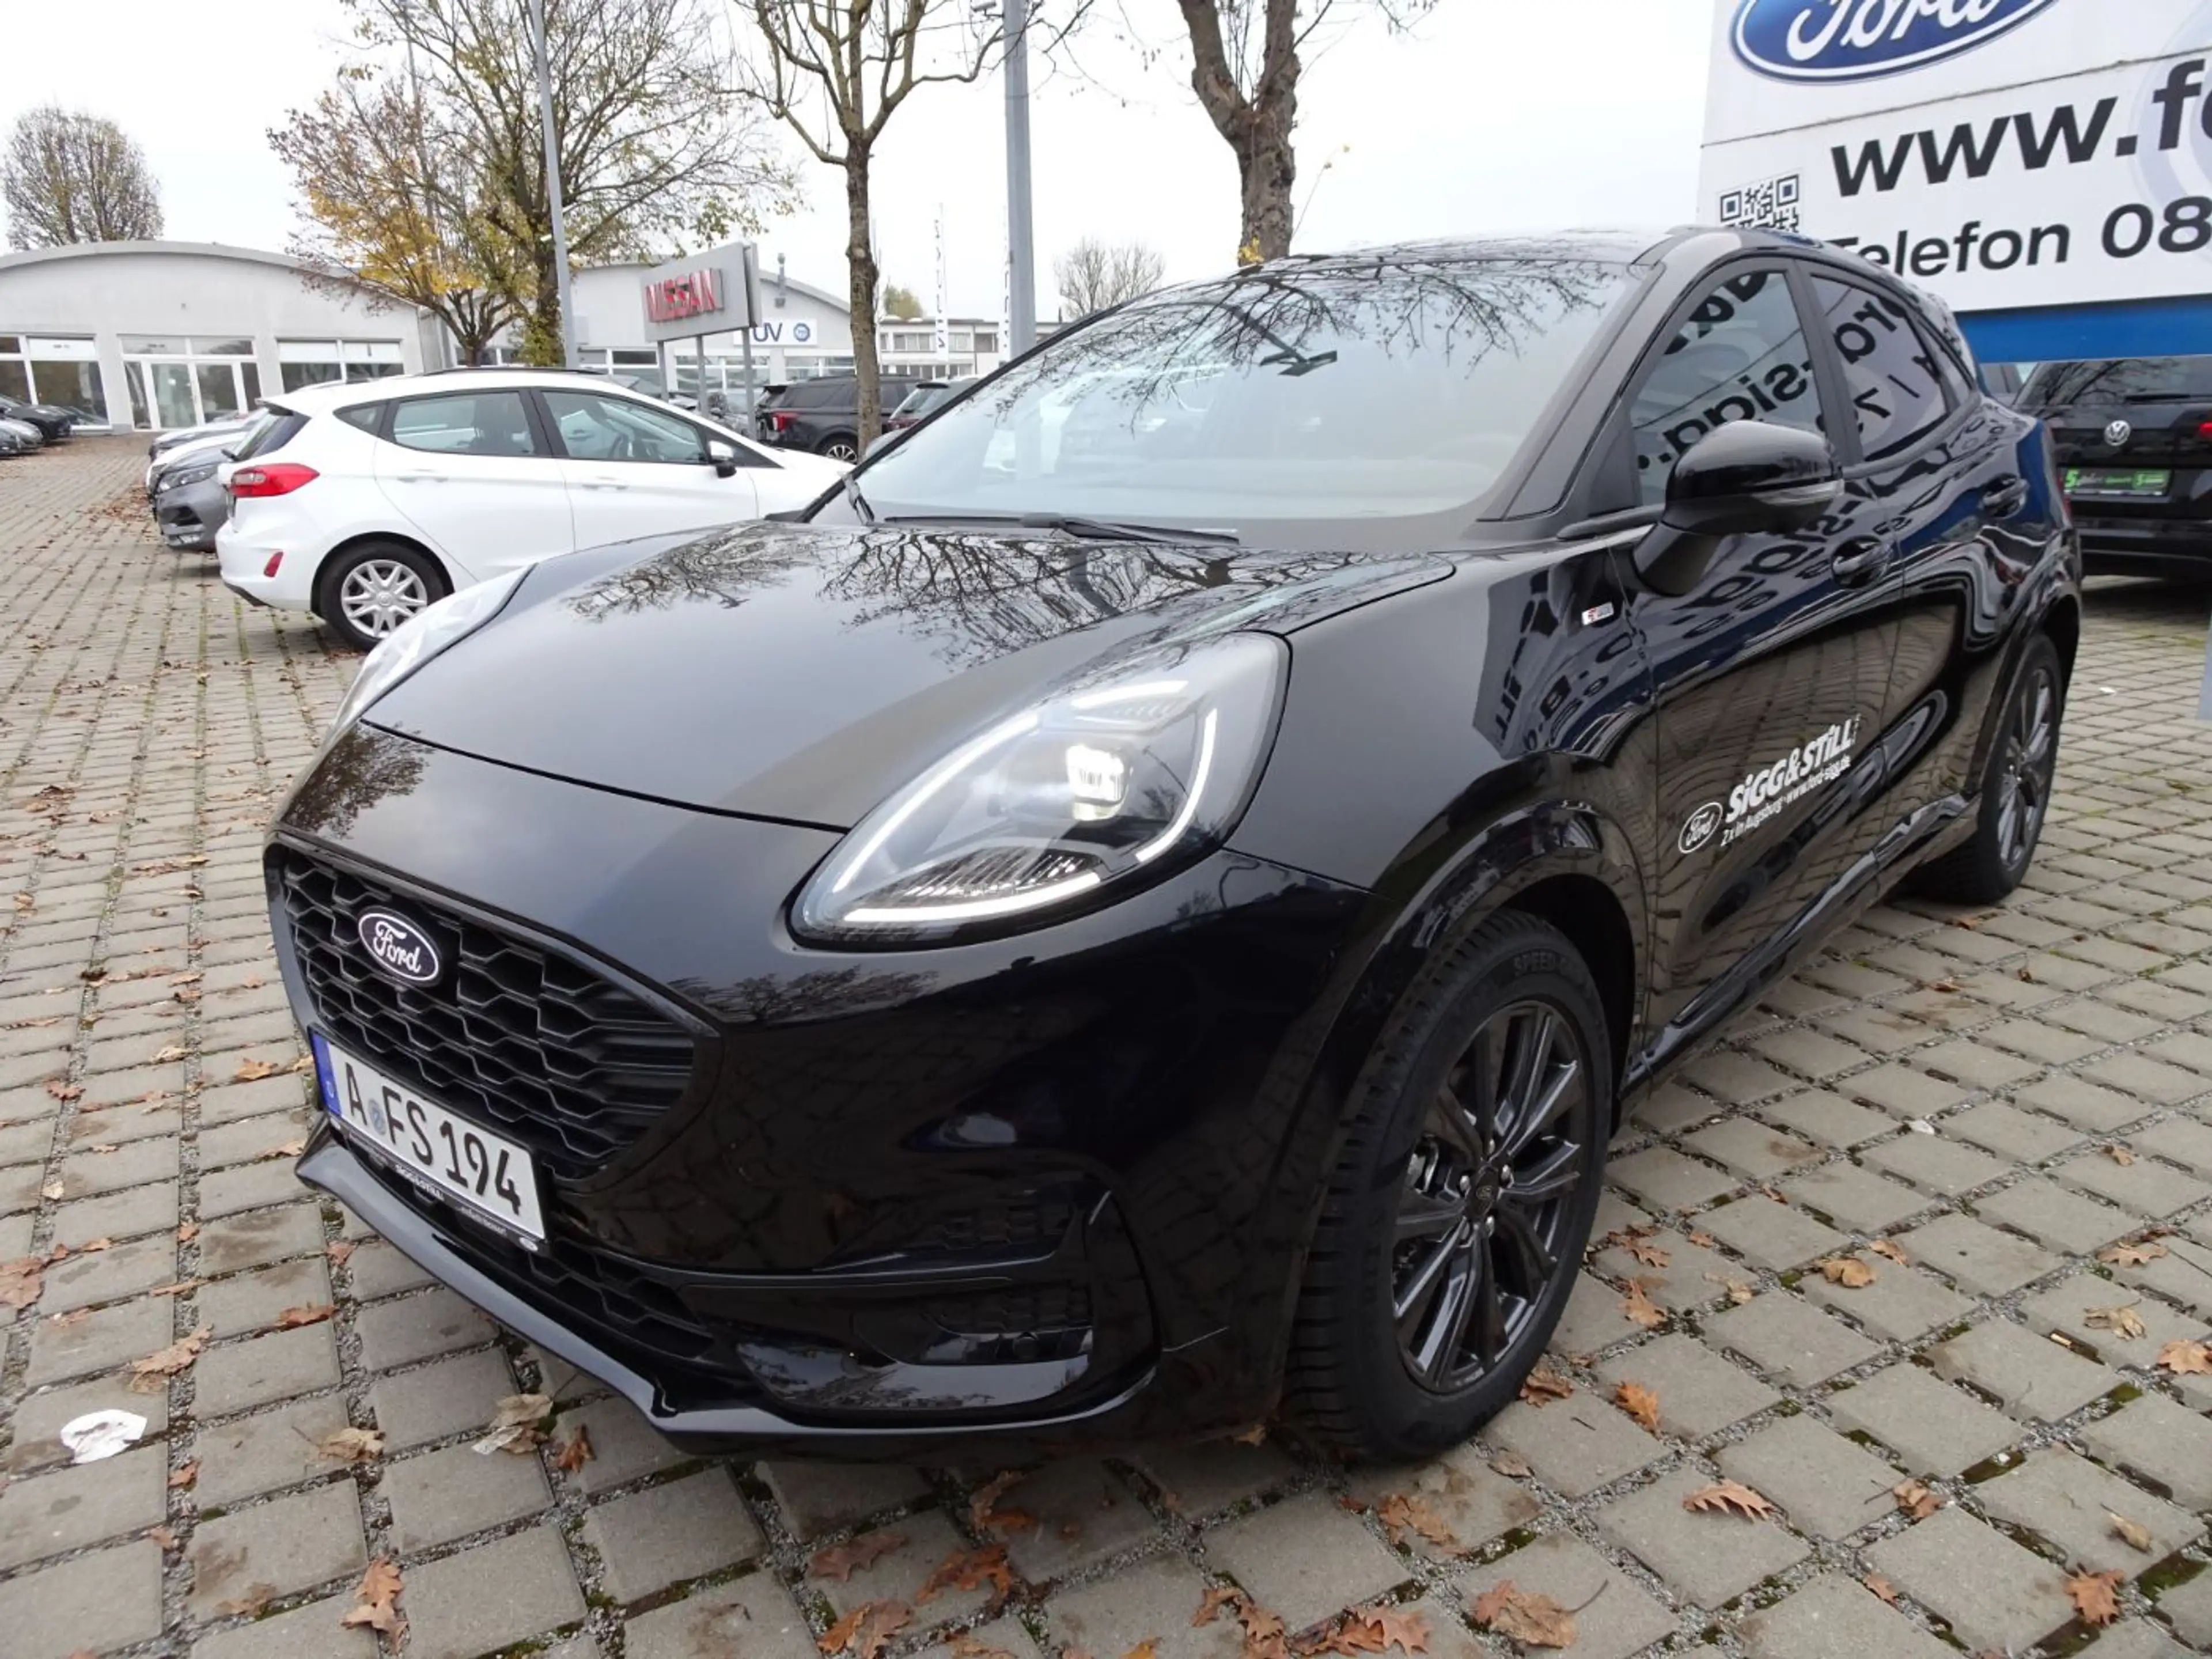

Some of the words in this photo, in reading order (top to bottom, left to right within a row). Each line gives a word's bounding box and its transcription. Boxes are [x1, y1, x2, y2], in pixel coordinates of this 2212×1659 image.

[1831, 59, 2212, 197] www.f
[645, 268, 723, 323] NISSAN
[373, 921, 422, 974] Ford
[345, 1062, 368, 1126] A
